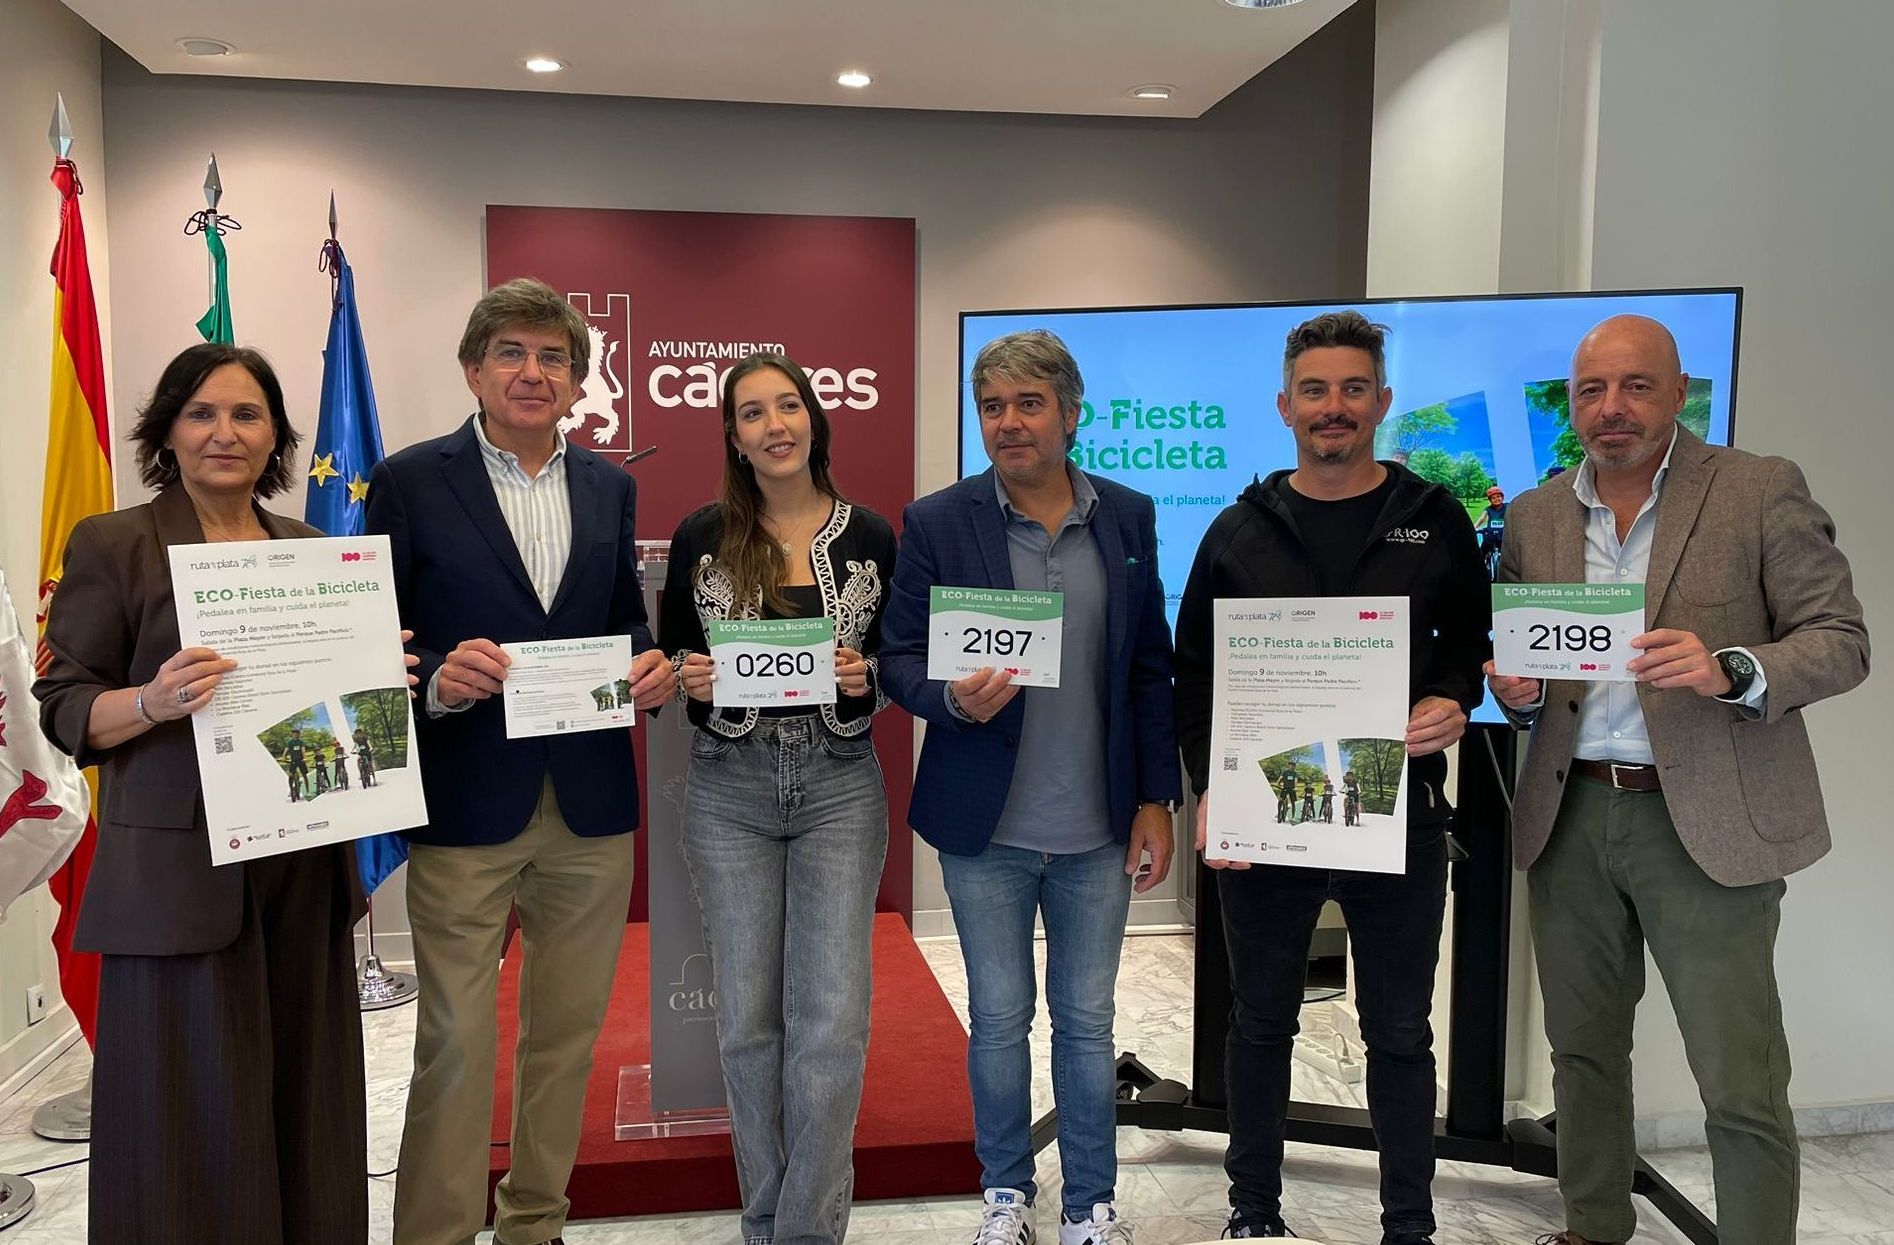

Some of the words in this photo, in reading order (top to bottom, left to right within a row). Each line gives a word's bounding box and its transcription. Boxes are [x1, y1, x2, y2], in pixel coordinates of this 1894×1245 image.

[649, 341, 785, 359] AYUNTAMIENTO
[648, 361, 879, 411] cáes
[1163, 495, 1173, 505] el
[1176, 495, 1225, 507] planeta!
[268, 553, 295, 561] ORIGEN
[194, 586, 286, 604] ECO-Fiesta
[290, 588, 303, 597] de
[305, 587, 316, 596] la
[317, 580, 380, 595] Bicicleta
[1564, 589, 1574, 597] de
[1575, 589, 1583, 597] la
[1584, 587, 1632, 597] Bicicleta
[1012, 594, 1052, 605] Bicicleta
[196, 608, 234, 619] ¡Pedalea
[249, 605, 277, 614] familia
[278, 605, 284, 613] y
[286, 602, 308, 611] cuida
[309, 601, 317, 609] el
[318, 600, 349, 609] planeta!
[200, 628, 238, 637] Domingo
[239, 624, 246, 634] 9
[785, 622, 823, 631] Bicicleta
[963, 627, 1033, 656] 2197
[1228, 637, 1304, 648] ECO-Fiesta
[1307, 640, 1320, 648] de
[1321, 640, 1331, 648] la
[1333, 637, 1394, 648] Bicicleta
[1528, 624, 1612, 652] 2198
[581, 641, 614, 650] Bicicleta
[1228, 652, 1258, 660] ¡Pedalea
[1332, 654, 1362, 662] planeta!
[736, 652, 815, 677] 0260
[1228, 669, 1258, 677] Domingo
[1259, 668, 1265, 676] 9
